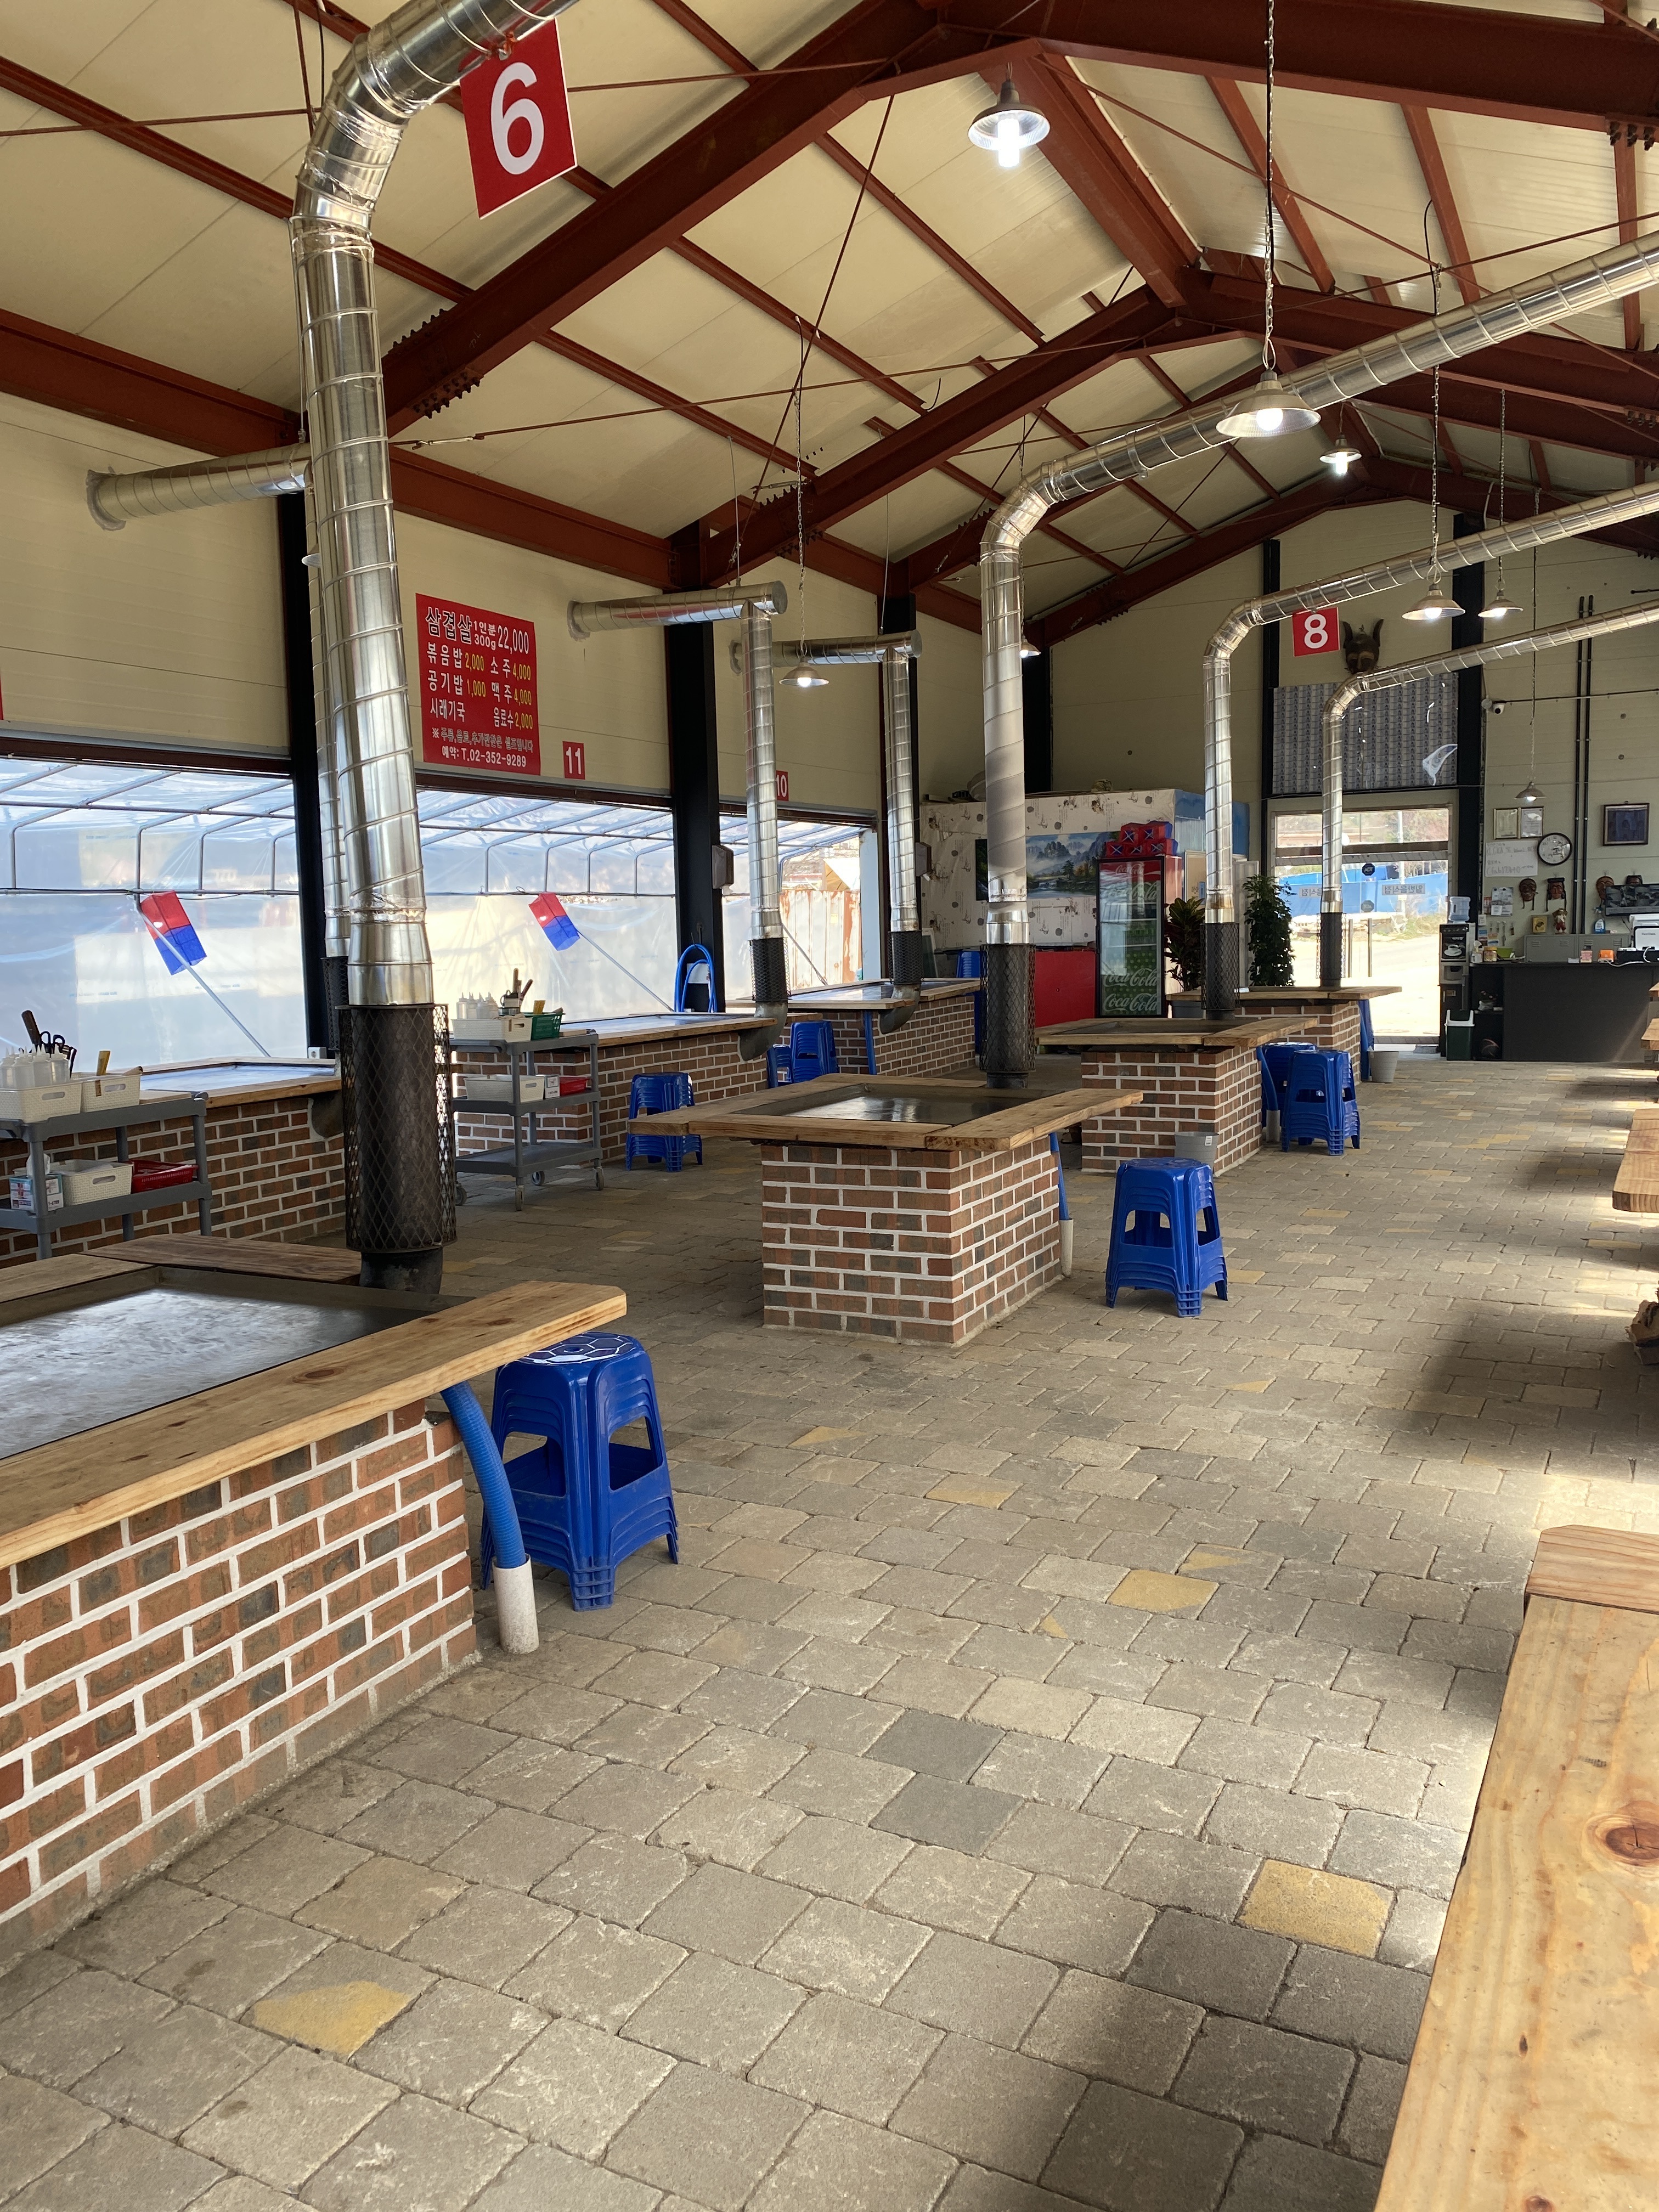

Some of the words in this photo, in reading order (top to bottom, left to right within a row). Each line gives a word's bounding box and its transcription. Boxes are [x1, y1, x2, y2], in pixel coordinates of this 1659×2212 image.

[491, 62, 544, 174] 6
[425, 606, 472, 645] 삼겹살
[473, 620, 496, 636] 1인분
[498, 625, 529, 654] 22,000
[474, 635, 496, 651] 300g
[1304, 614, 1328, 649] 8
[427, 641, 463, 669] 볶음밥
[465, 652, 484, 672] 2,000
[490, 656, 511, 679] 소주
[512, 664, 531, 681] 4,000
[427, 669, 464, 696] 공기밥
[466, 680, 486, 698] 1,000
[491, 681, 512, 704] 맥주
[514, 689, 532, 706] 4,000
[430, 697, 465, 723] 시래기국
[493, 707, 514, 729] 음료수
[515, 712, 533, 730] 2,000
[442, 745, 459, 760] 예약:
[566, 747, 582, 775] 11
[776, 774, 787, 797] 10
[1102, 992, 1157, 1014] Coca-Cola
